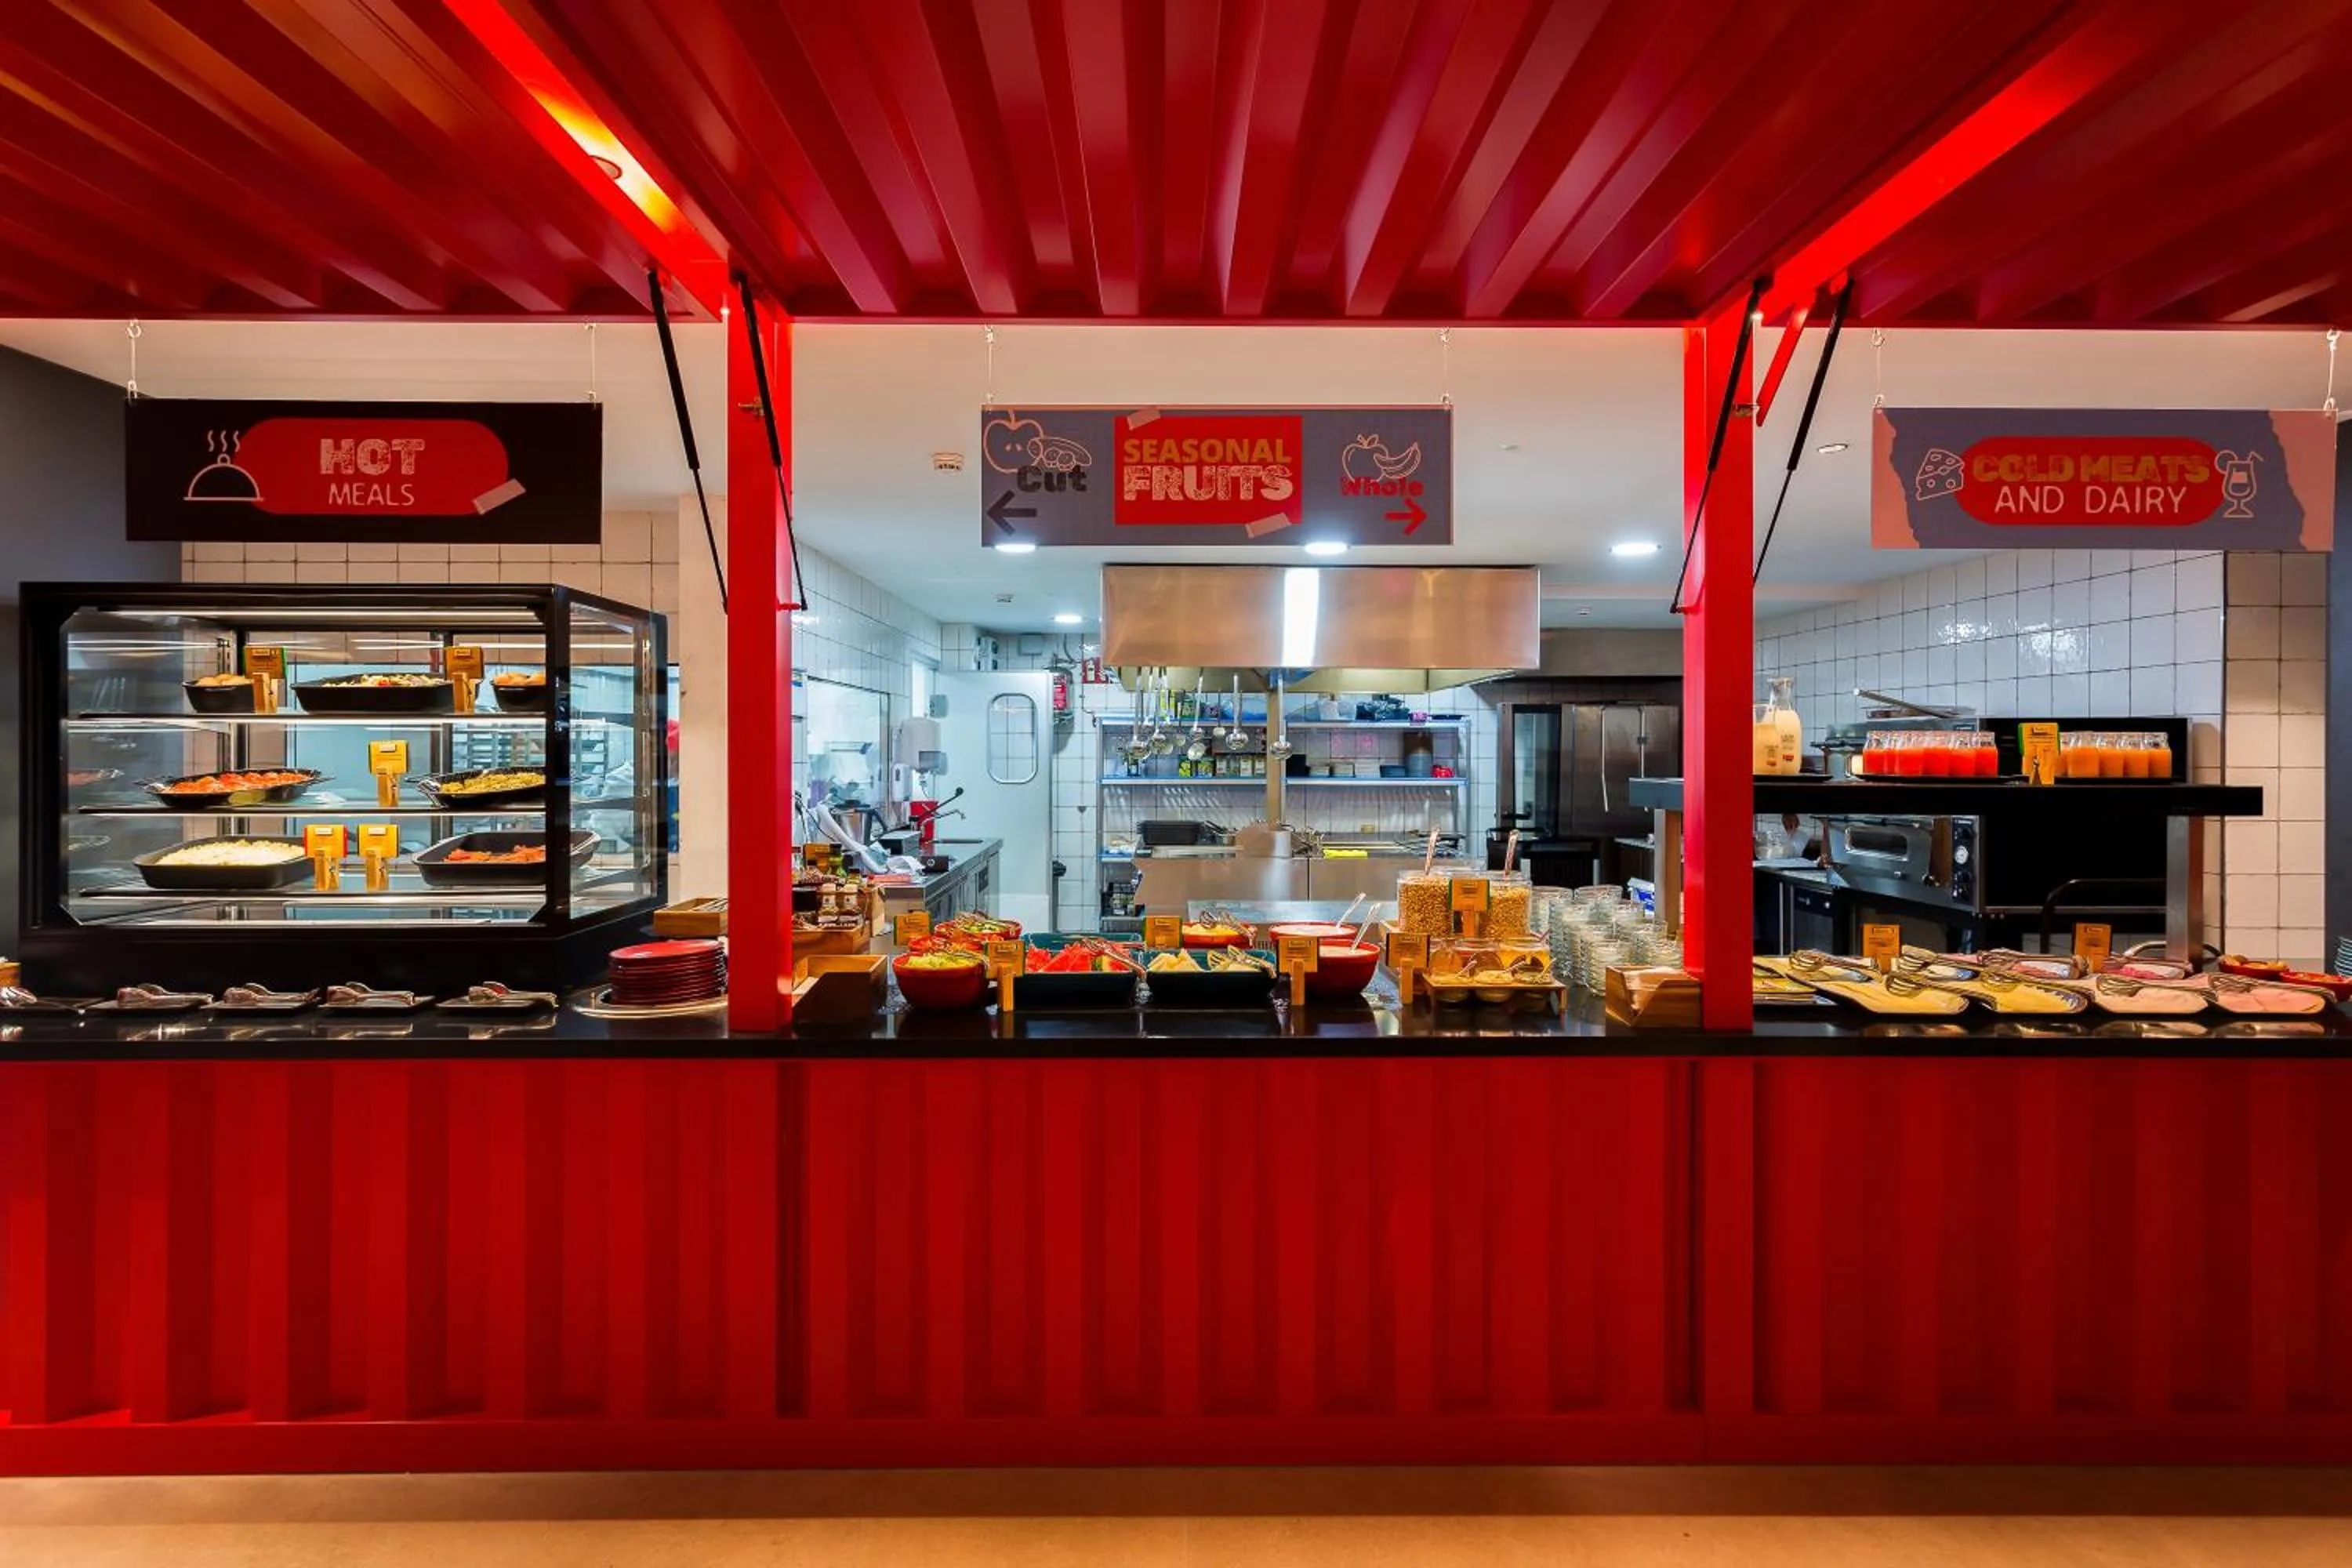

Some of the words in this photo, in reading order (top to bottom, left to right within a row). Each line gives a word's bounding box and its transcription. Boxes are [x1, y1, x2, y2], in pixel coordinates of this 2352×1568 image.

[320, 438, 426, 475] HOT
[1123, 438, 1292, 463] SEASONAL
[1018, 465, 1087, 492] Cut
[1123, 465, 1294, 501] FRUITS
[1973, 455, 2074, 482] COLD
[2080, 455, 2210, 484] MEATS
[328, 483, 415, 506] MEALS
[1340, 477, 1424, 497] Whole
[1994, 485, 2064, 514] AND
[2085, 485, 2187, 514] DAIRY
